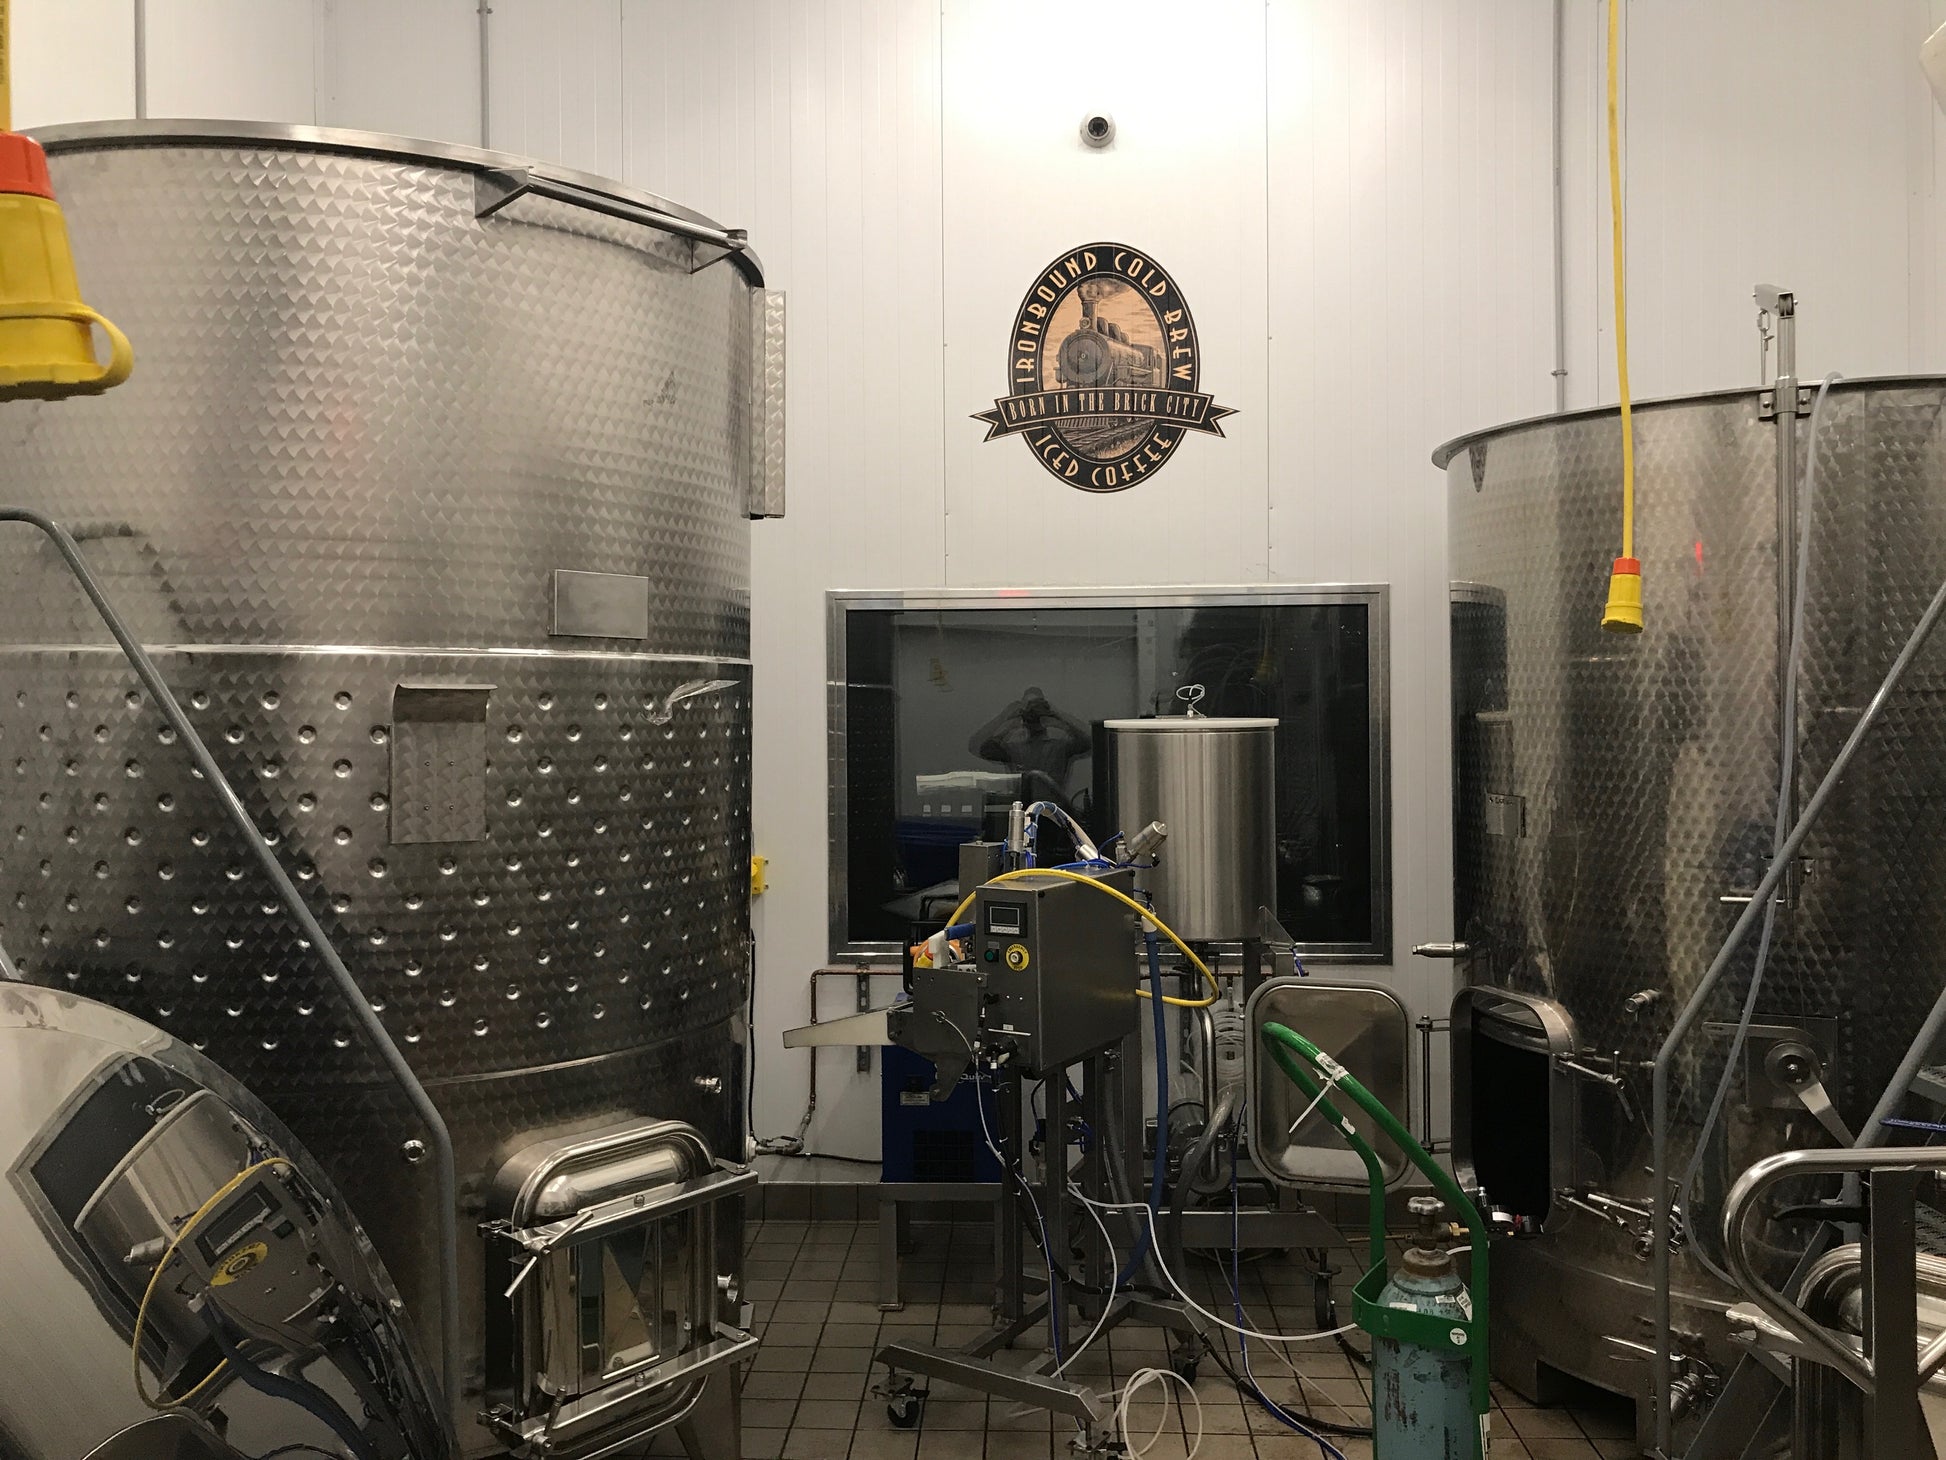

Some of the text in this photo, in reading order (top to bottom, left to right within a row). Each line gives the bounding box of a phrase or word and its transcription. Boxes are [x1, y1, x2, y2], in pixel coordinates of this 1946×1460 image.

[1015, 251, 1192, 383] IRONBOUND COLD BREW
[1008, 392, 1200, 421] BORN IN THE BRICK CITY
[1035, 432, 1172, 487] ICED COFFEE
